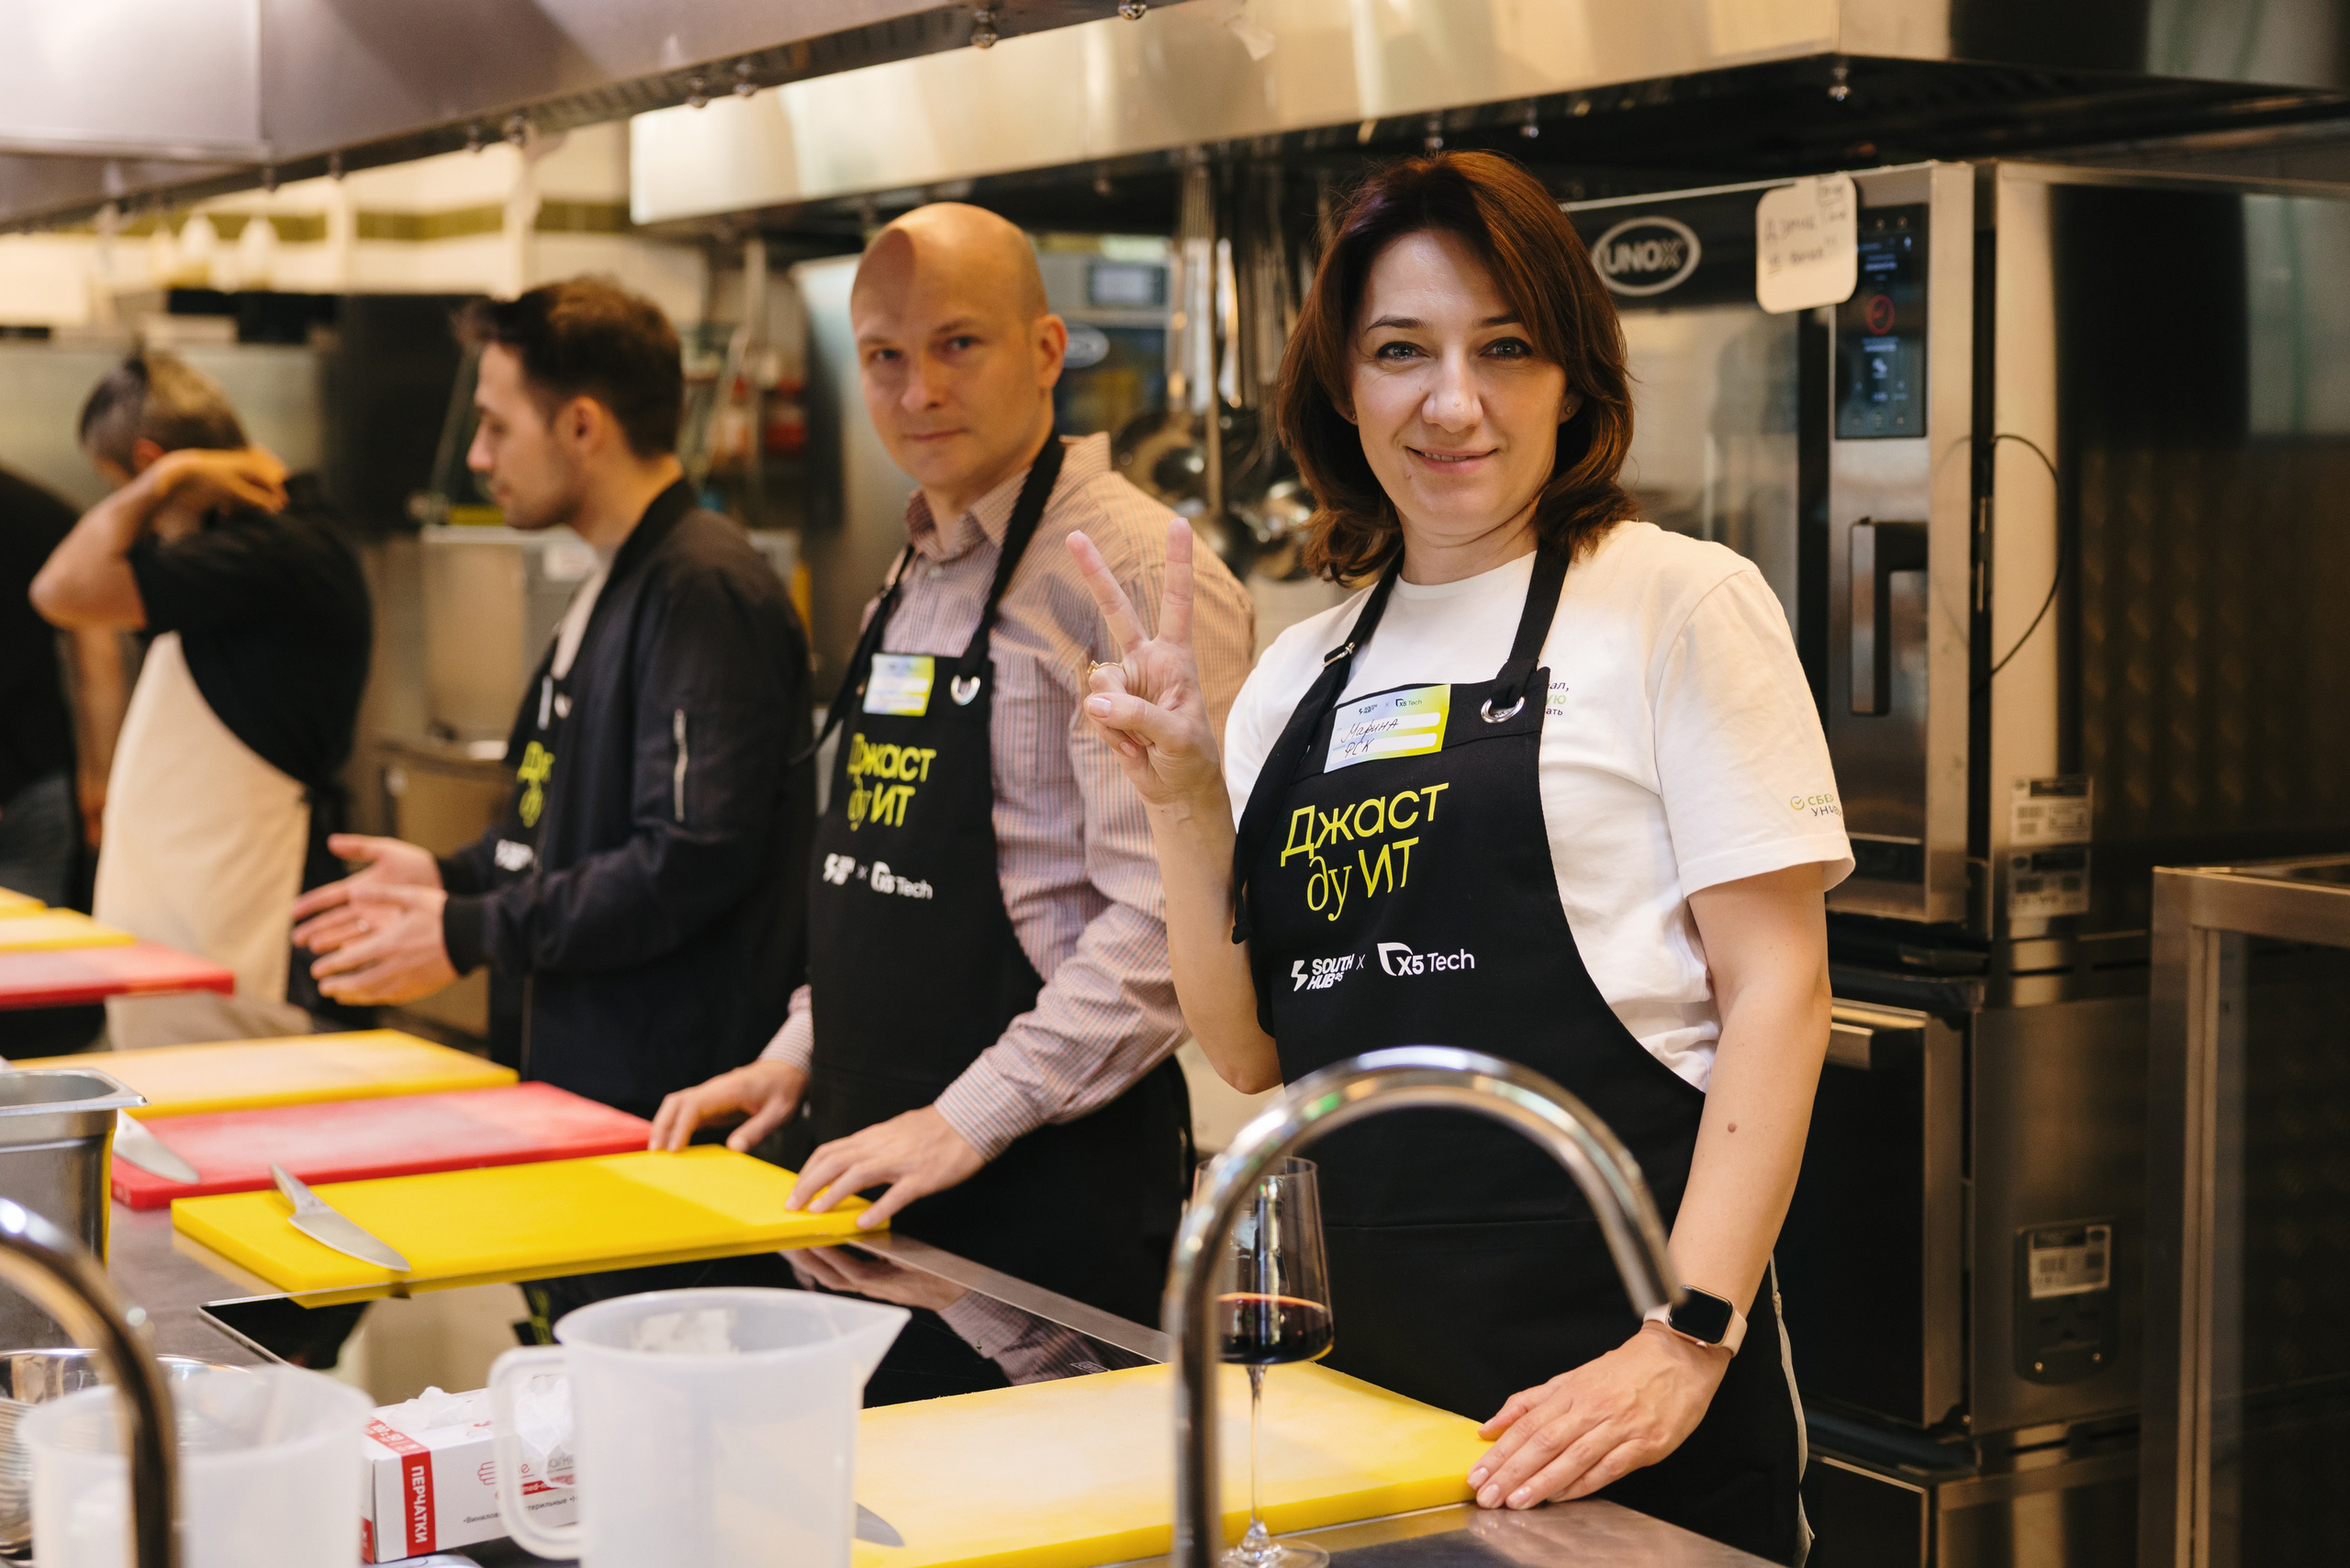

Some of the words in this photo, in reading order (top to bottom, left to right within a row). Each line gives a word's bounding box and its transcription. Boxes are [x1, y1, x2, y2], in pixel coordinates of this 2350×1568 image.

[1603, 239, 1684, 274] UNOX
[1281, 782, 1449, 867] Джаст
[1306, 856, 1352, 921] ду
[1358, 836, 1419, 899] ИТ
[1312, 954, 1355, 975] SOUTH
[1427, 948, 1475, 972] Tech
[411, 1465, 429, 1543] ПЕРЧАТКИ
